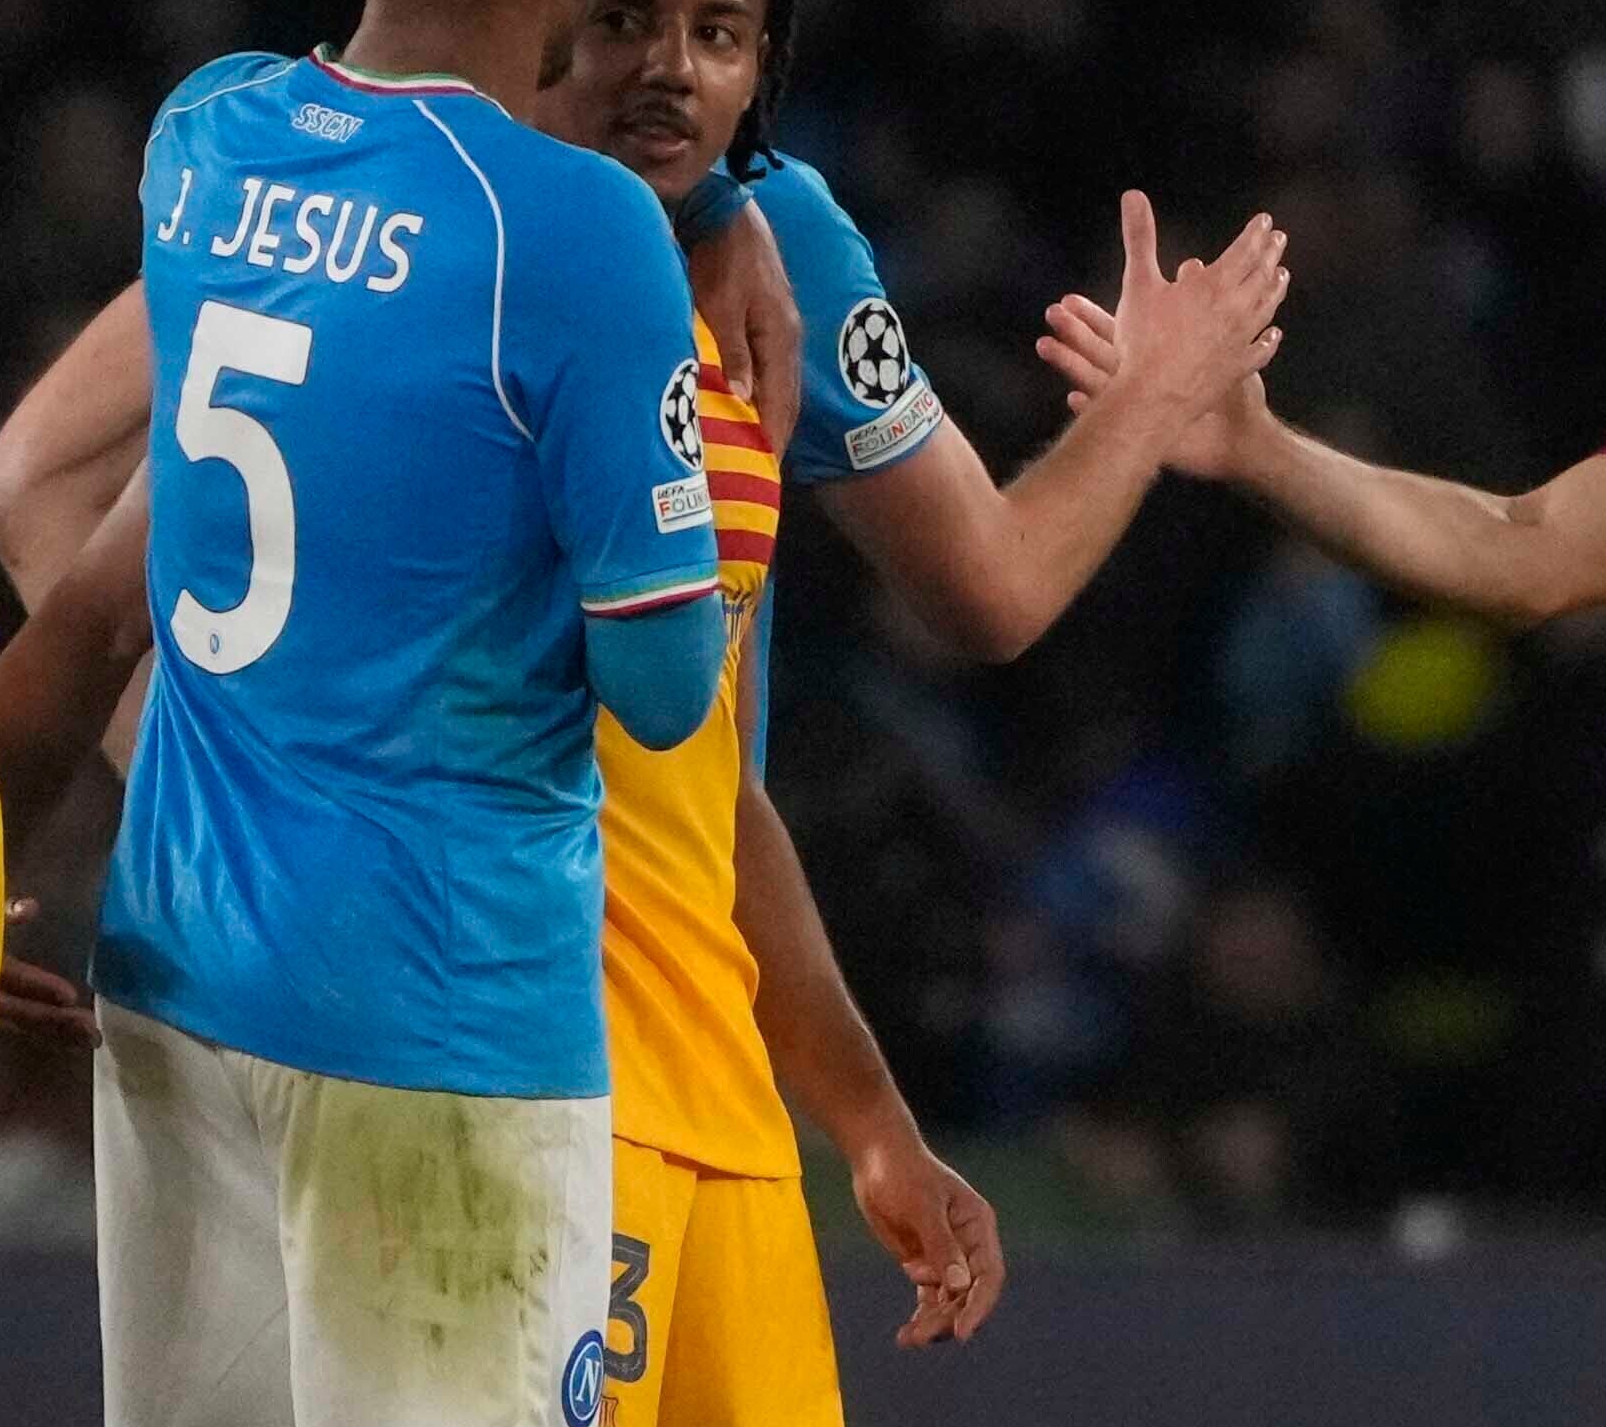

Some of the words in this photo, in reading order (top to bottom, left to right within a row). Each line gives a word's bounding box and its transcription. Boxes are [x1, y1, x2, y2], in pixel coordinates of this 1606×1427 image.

[157, 167, 193, 246] J.
[210, 177, 425, 294] JESUS
[171, 300, 313, 676] 5
